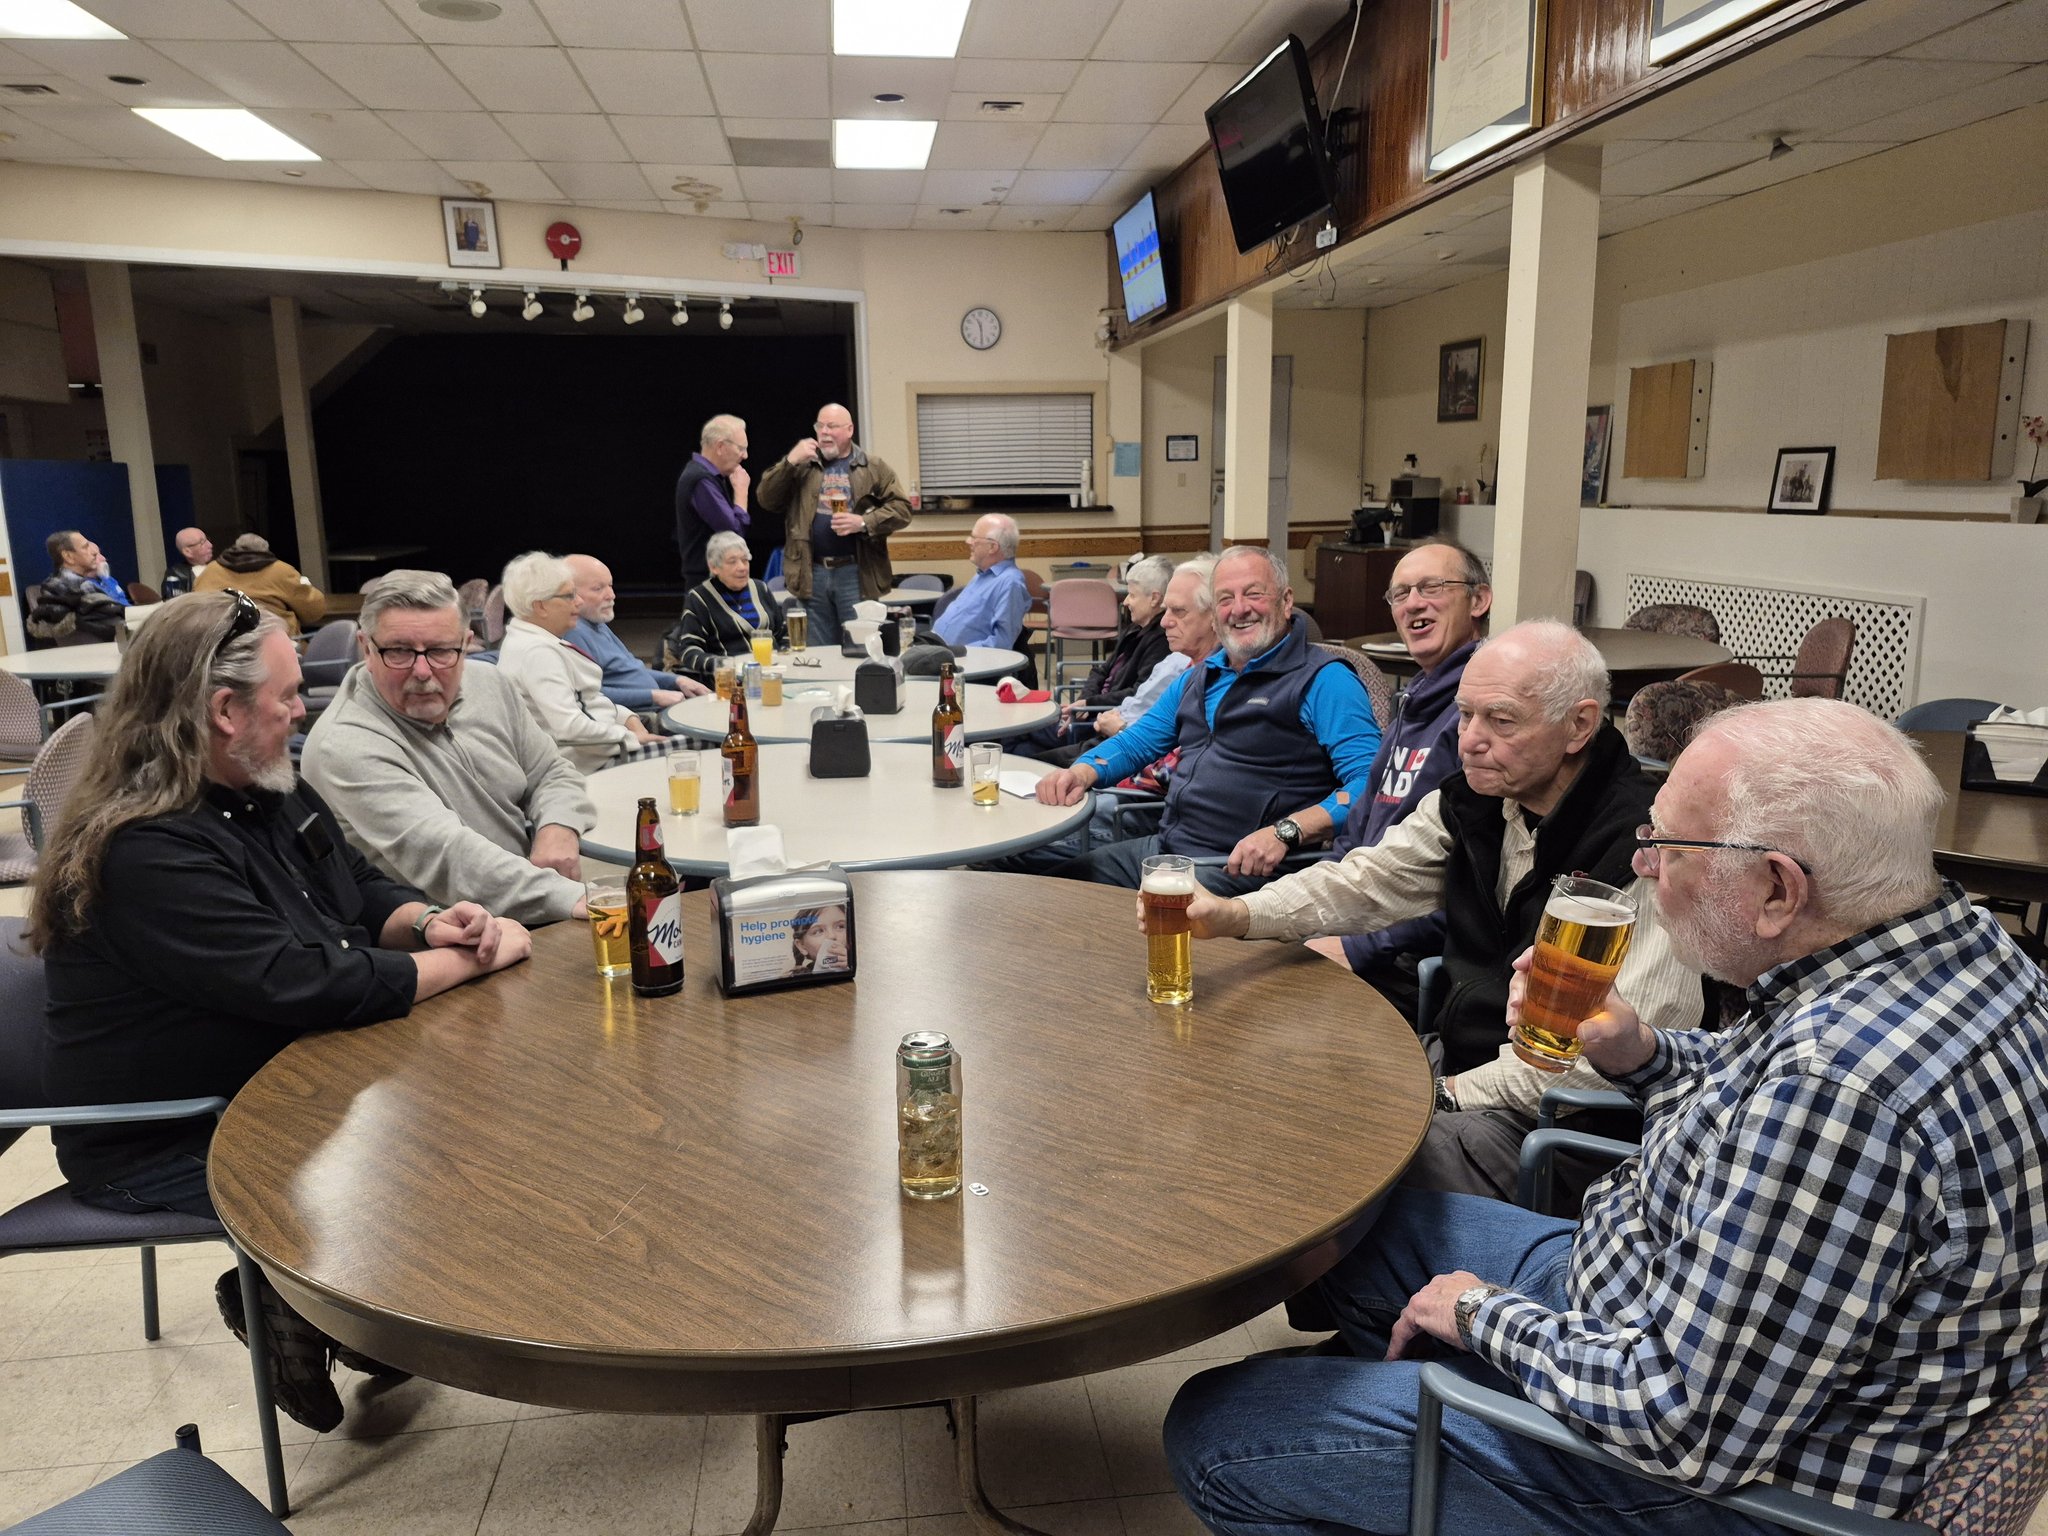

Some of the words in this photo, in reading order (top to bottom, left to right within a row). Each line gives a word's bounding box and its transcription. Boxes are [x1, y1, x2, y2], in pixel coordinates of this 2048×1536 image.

[768, 252, 794, 274] EXIT
[740, 921, 767, 932] Help
[771, 915, 818, 930] promote
[741, 932, 786, 945] hygiene
